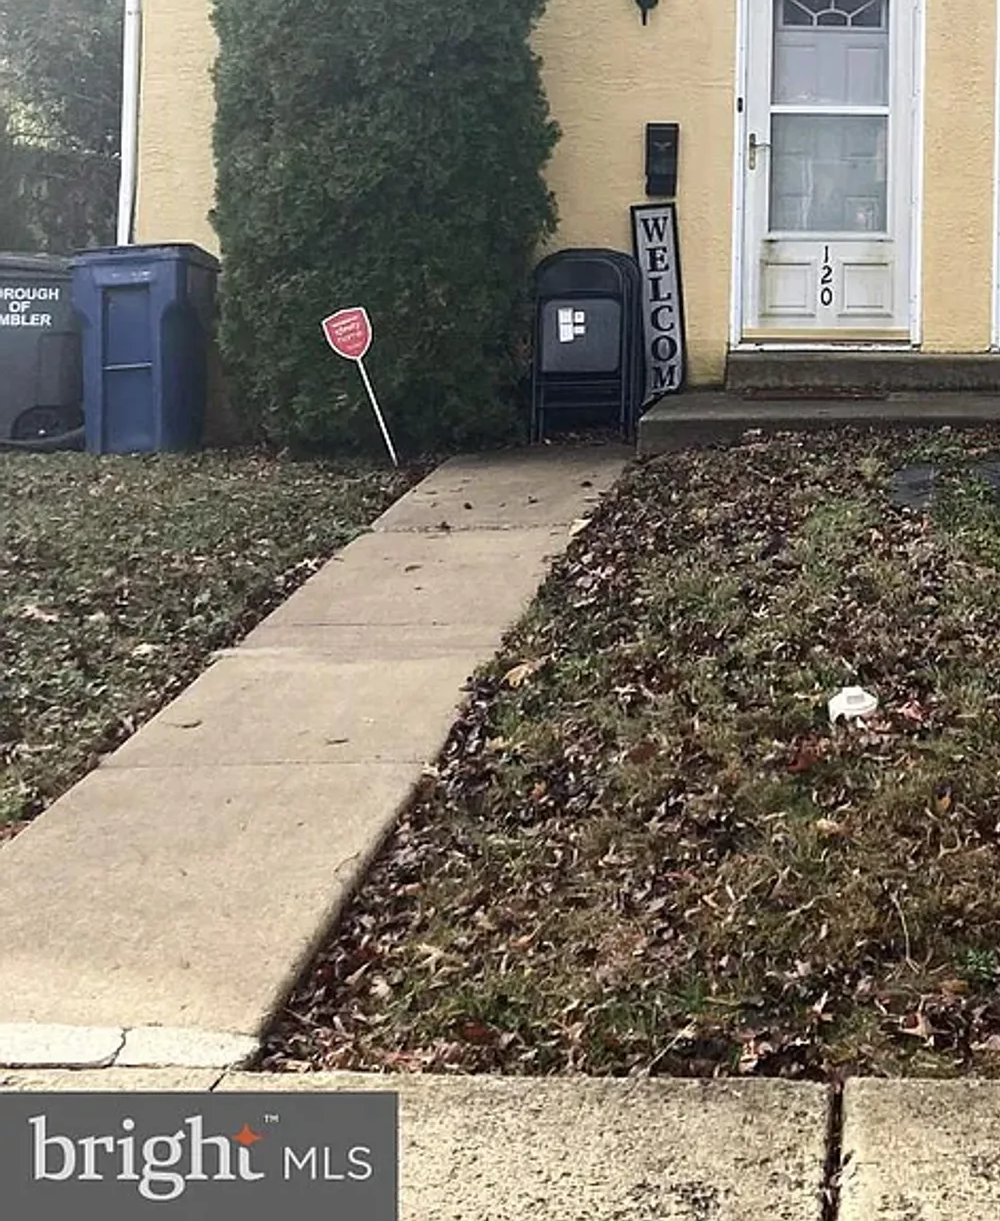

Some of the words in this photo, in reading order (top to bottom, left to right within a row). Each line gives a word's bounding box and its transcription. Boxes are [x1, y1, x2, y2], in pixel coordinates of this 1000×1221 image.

[0, 287, 60, 301] ROUGH
[820, 245, 833, 307] 120
[8, 301, 31, 313] OF
[639, 215, 679, 395] WELCOM
